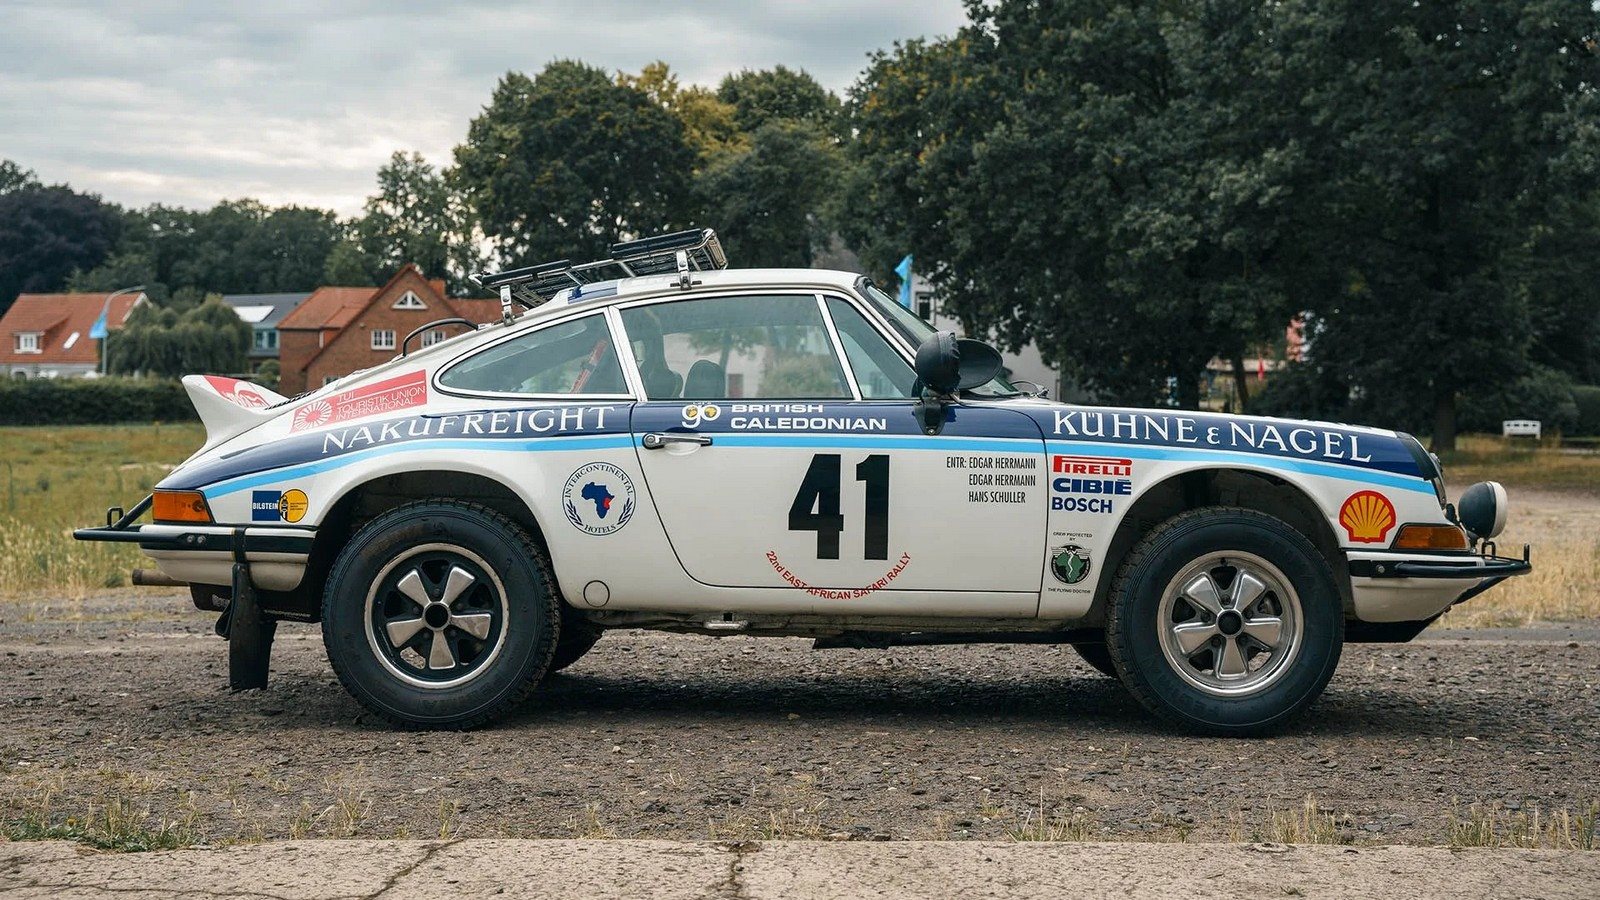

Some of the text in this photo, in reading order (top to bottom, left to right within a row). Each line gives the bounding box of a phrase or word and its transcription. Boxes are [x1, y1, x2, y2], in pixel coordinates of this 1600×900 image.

[337, 386, 426, 413] TOURISTIK UNION
[339, 391, 354, 402] TUI
[336, 397, 417, 420] INTERNATIONAL
[731, 404, 824, 413] BRITISH
[322, 406, 615, 453] NAKUFREIGHT
[731, 417, 886, 430] CALEDONIAN
[1053, 410, 1198, 444] KÜHNE
[1229, 421, 1372, 463] NAGEL
[946, 456, 1036, 469] ENTR: EDGAR HERRMANN
[1053, 455, 1133, 476] PIRELLI
[565, 464, 633, 498] INTERCONTINENTAL
[969, 474, 1036, 486] EDGAR HERRMANN
[252, 502, 279, 510] BILSTEIN
[968, 491, 1026, 503] HANS SCHULLER
[1052, 496, 1113, 514] BOSCH
[788, 453, 890, 560] 41
[584, 523, 617, 534] HOTELS
[766, 550, 911, 600] 22nd EAST AFRICAN SAFARI RALLY
